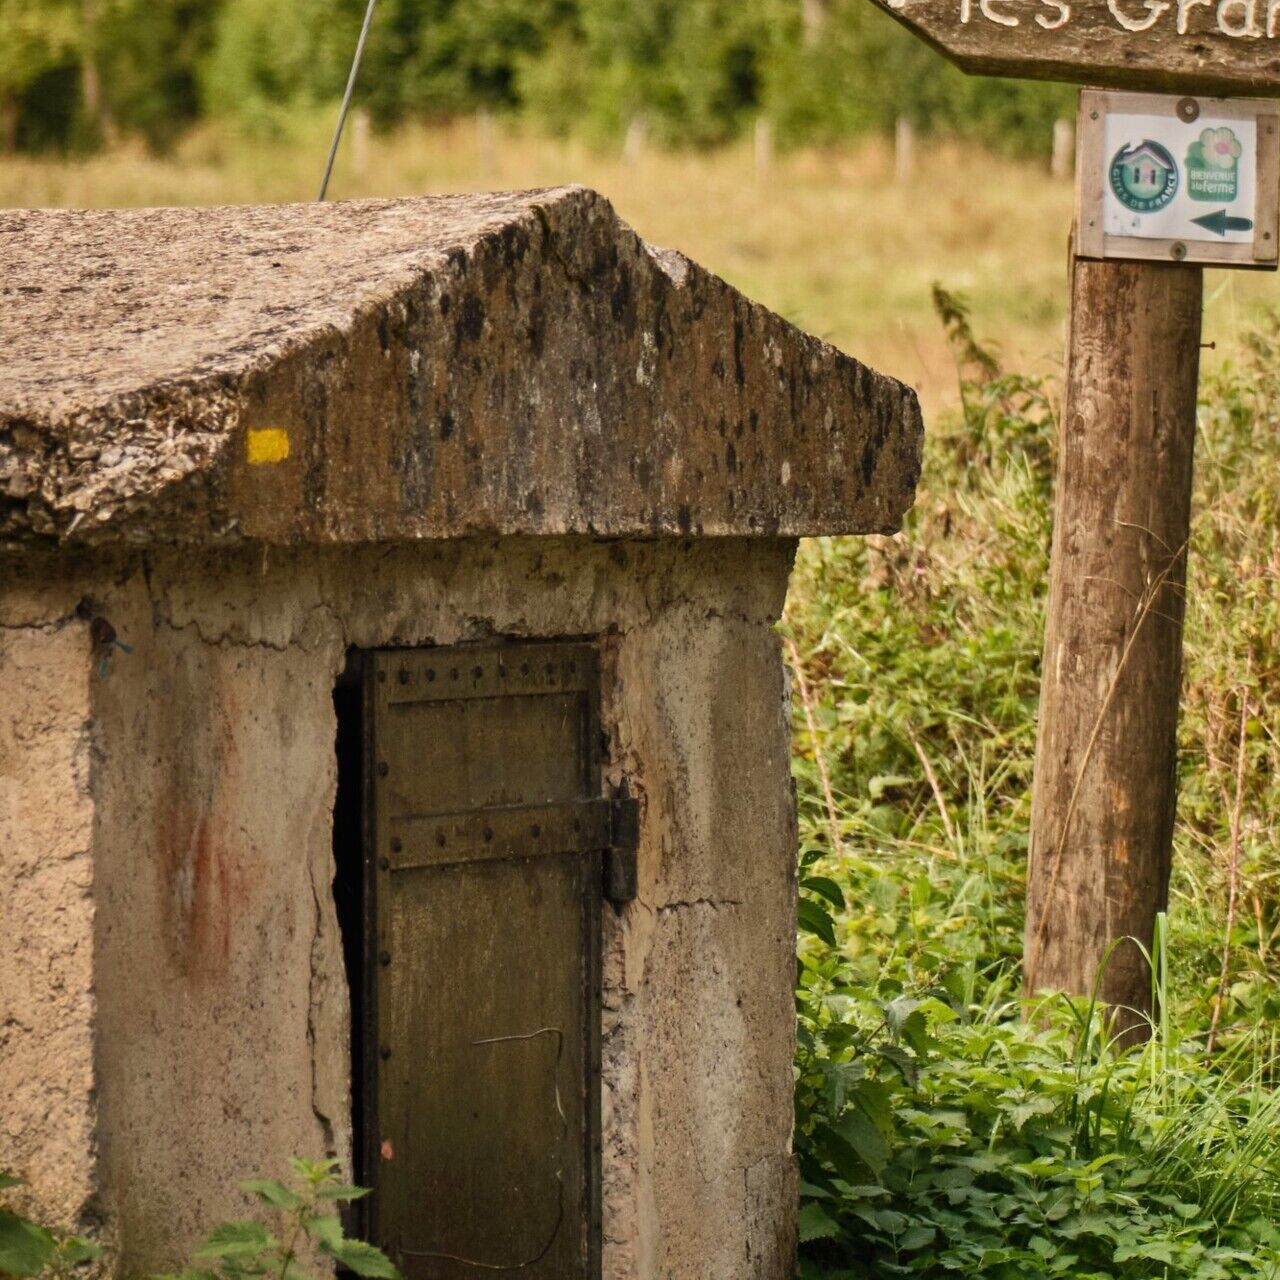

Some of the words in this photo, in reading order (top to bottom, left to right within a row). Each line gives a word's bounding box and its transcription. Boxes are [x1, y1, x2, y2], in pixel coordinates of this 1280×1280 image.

[1190, 170, 1235, 181] BIENVENUE
[1148, 173, 1176, 208] FRANCE
[1202, 180, 1235, 193] ferme
